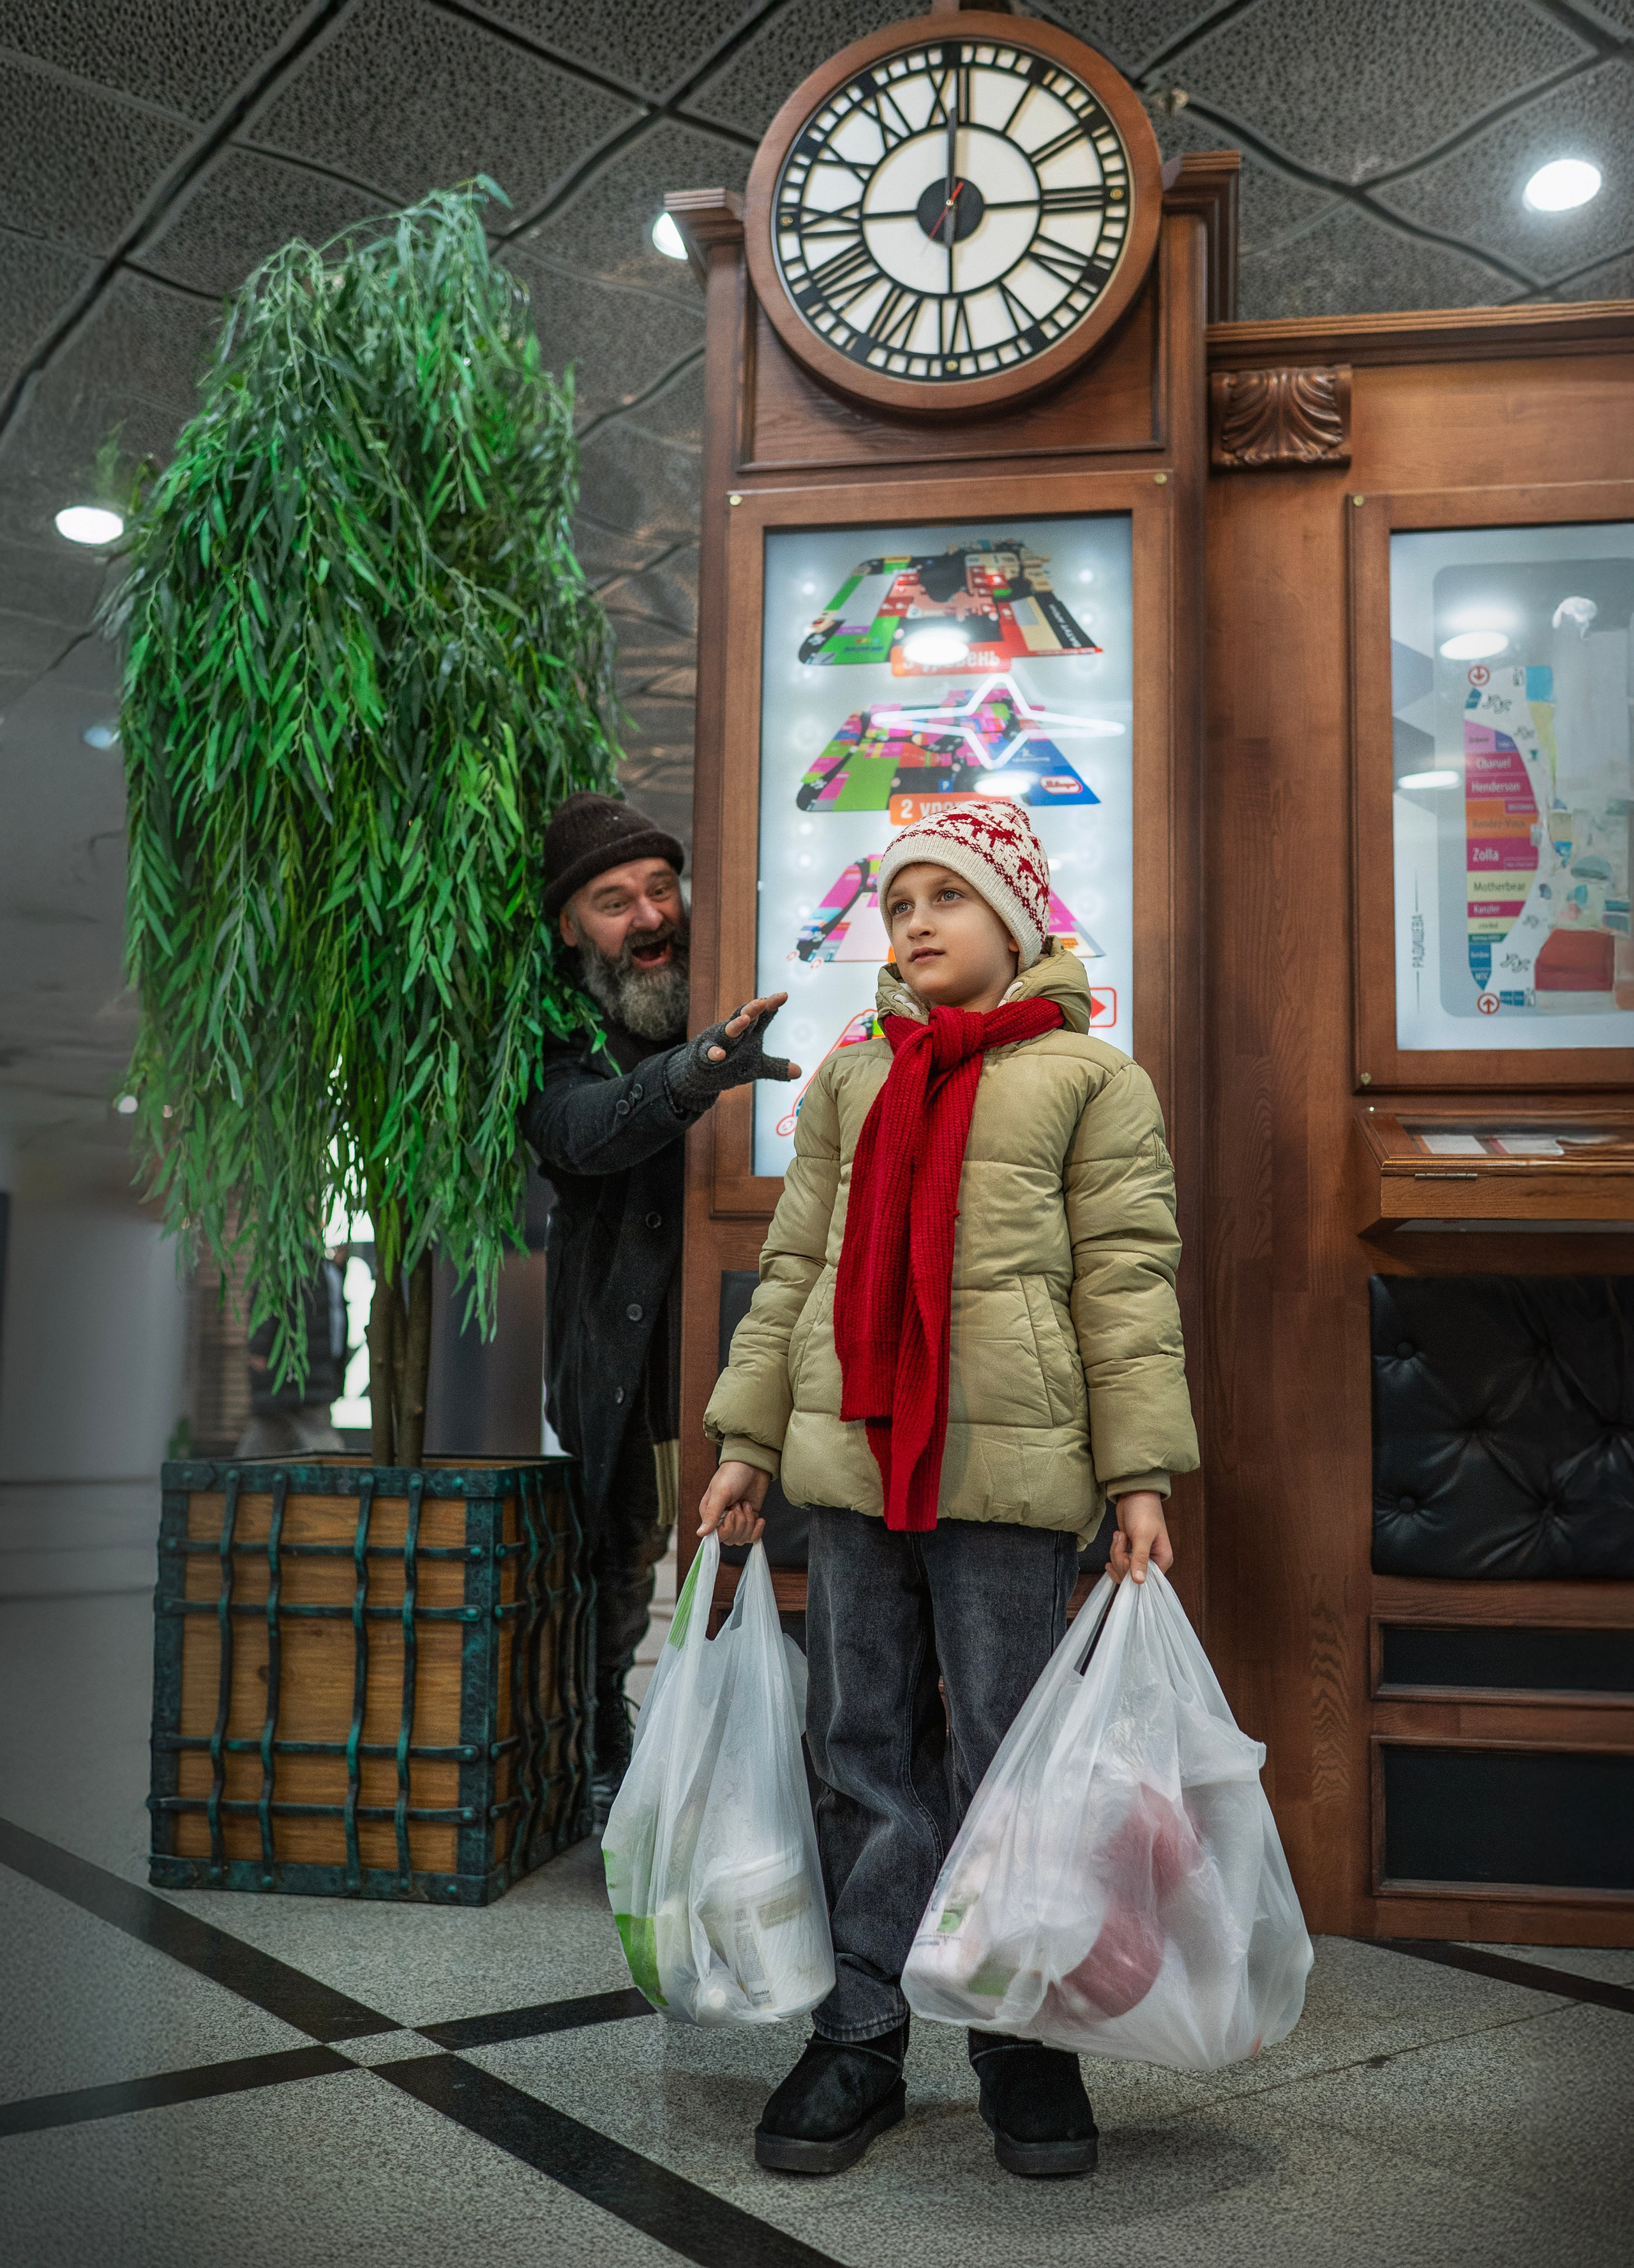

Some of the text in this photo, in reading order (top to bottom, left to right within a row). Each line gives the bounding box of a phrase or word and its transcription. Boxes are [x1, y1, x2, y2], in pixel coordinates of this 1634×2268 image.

[1471, 781, 1520, 792] Henderson
[901, 799, 913, 818] 2
[1473, 847, 1499, 862] Zolla
[1473, 882, 1525, 892] Motherbear
[1473, 904, 1500, 913] Kanzler
